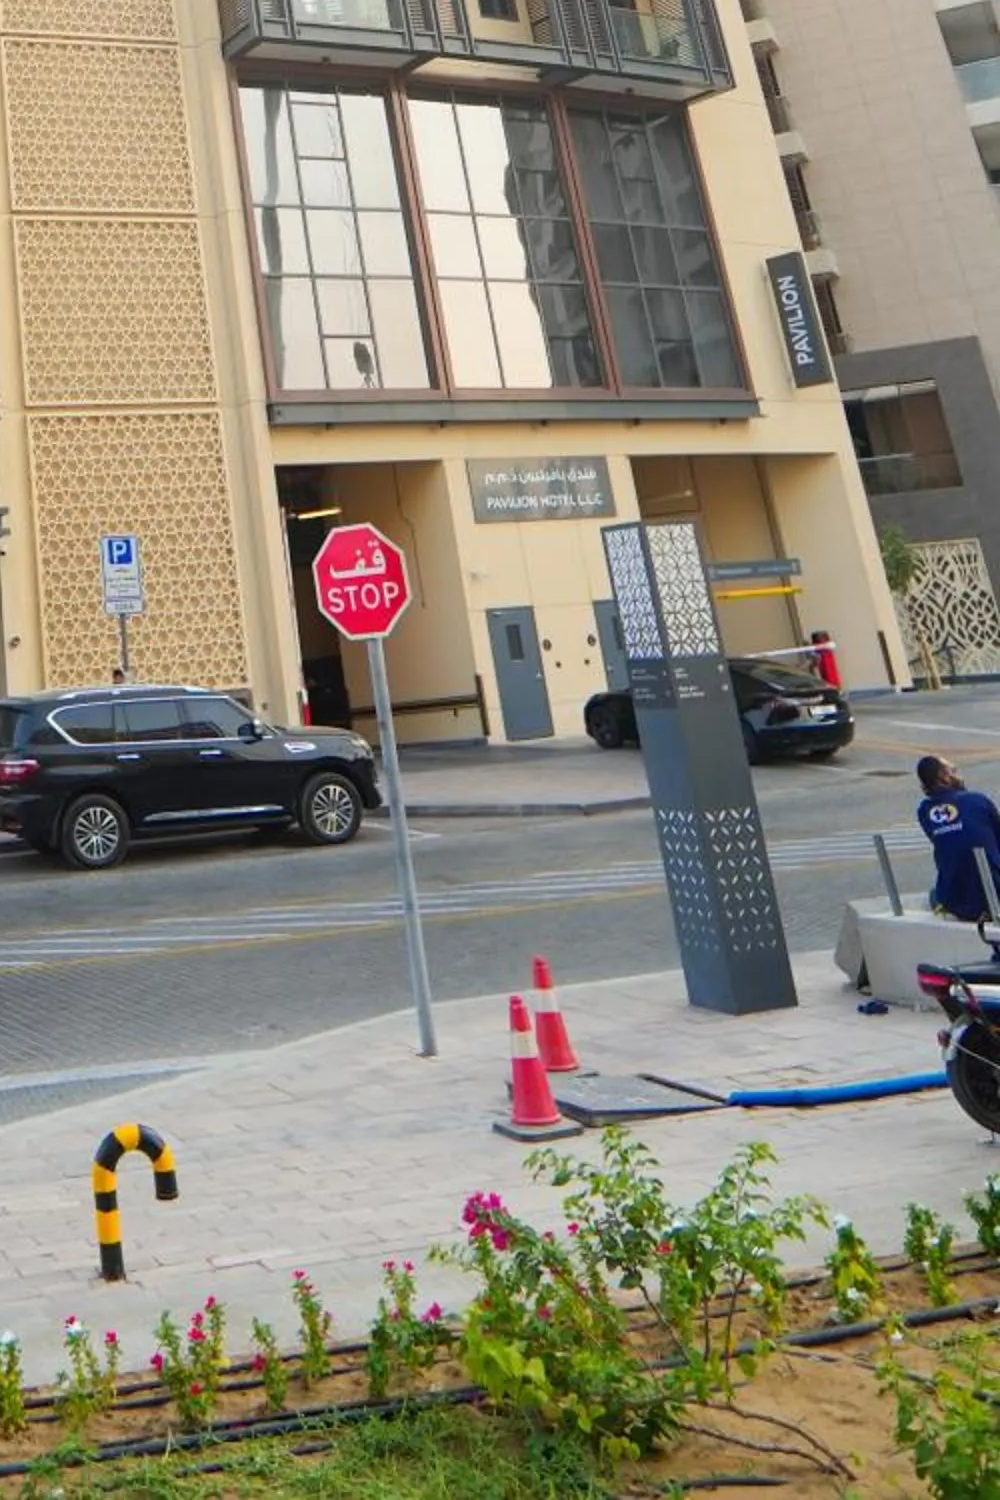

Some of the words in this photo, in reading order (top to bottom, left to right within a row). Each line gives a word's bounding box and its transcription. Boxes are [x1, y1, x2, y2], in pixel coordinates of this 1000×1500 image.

[777, 275, 815, 366] PAVILION
[487, 495, 538, 509] PAVILION
[541, 493, 577, 508] HOTEL
[112, 541, 127, 563] P
[329, 539, 387, 579] قف
[327, 581, 399, 613] STOP
